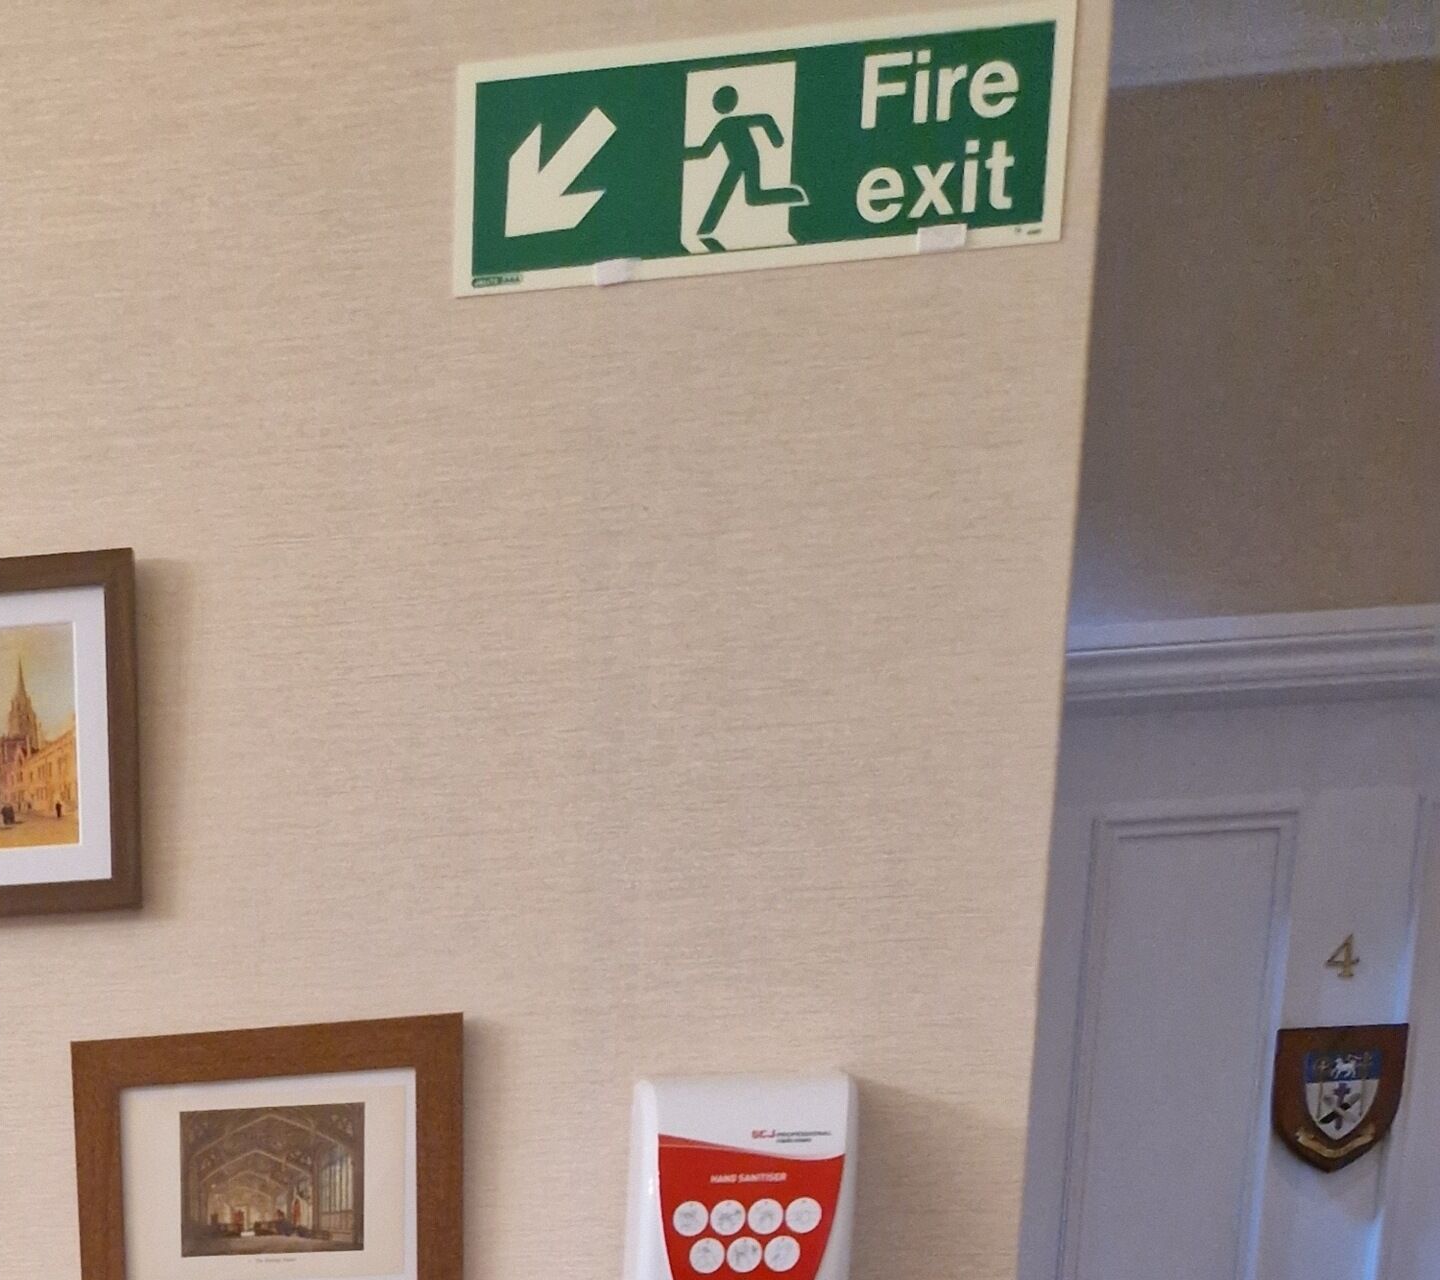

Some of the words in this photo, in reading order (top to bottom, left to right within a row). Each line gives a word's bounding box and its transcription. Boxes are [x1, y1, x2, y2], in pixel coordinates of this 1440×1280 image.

[860, 50, 1019, 130] Fire
[857, 140, 1015, 223] exit
[1326, 934, 1360, 977] 4
[710, 1174, 737, 1183] HAND
[738, 1172, 787, 1183] SANITISER
